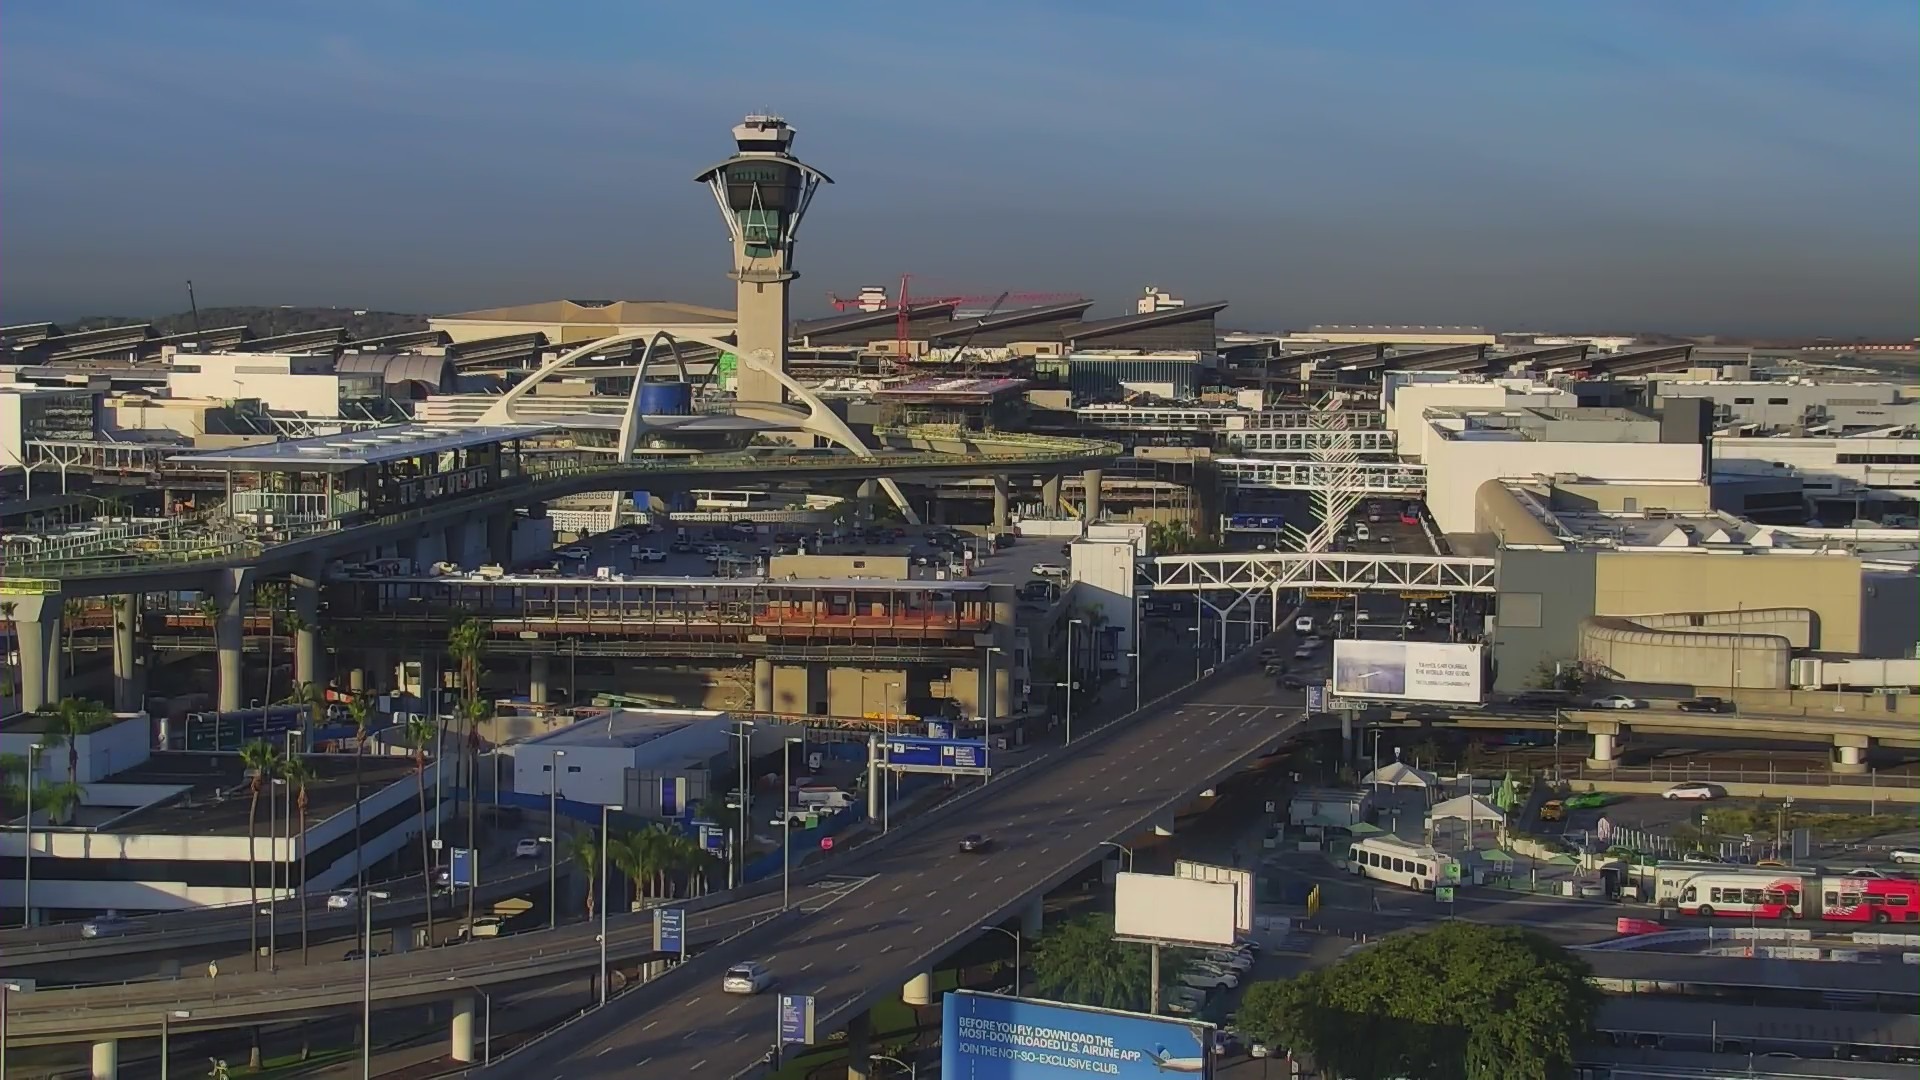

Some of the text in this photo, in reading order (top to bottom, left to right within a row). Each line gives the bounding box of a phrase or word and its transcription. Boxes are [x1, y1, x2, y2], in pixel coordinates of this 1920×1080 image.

[1128, 528, 1135, 538] P
[1114, 546, 1121, 556] P
[959, 1016, 1114, 1048] BEFORE YOU FLY, DOWNLOAD THE
[959, 1027, 1142, 1062] MOST-DOWNLOADED U.S. AIRLINE APP.
[959, 1041, 1120, 1075] JOIN THE NOT-SO-EXCLUSIVE CLUB.
